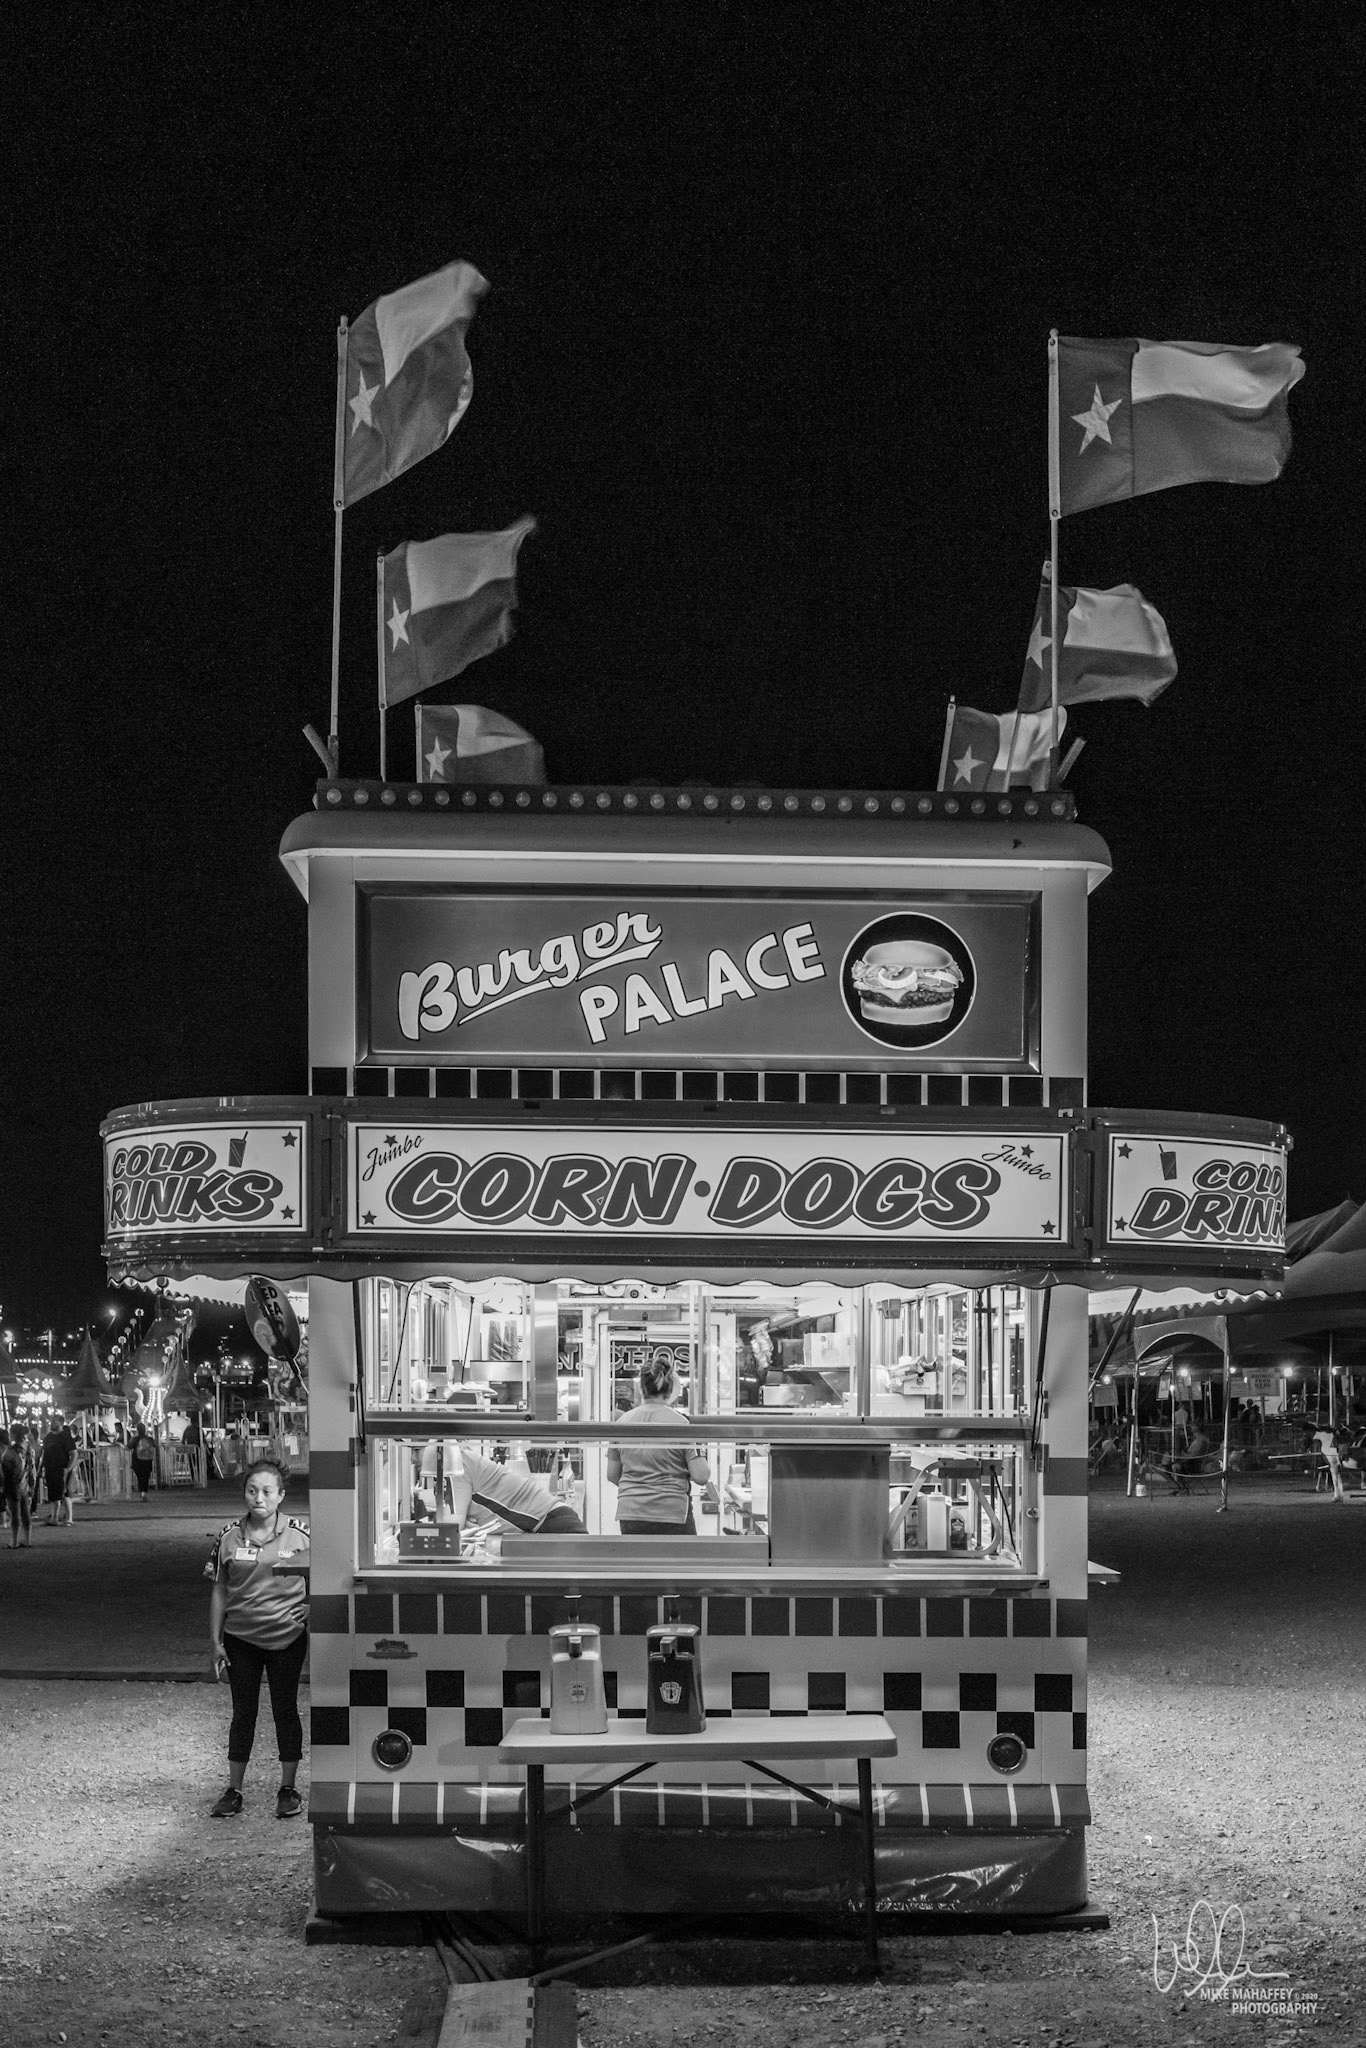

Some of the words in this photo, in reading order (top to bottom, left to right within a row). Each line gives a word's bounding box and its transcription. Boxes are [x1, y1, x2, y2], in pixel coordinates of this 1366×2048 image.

[398, 912, 662, 1041] Burger
[578, 922, 827, 1044] PALACE
[111, 1141, 216, 1181] COLD
[362, 1135, 425, 1181] Jumbo
[982, 1144, 1052, 1181] Jumbo
[1192, 1159, 1285, 1197] COLD
[106, 1169, 283, 1228] RINKS
[1129, 1187, 1286, 1245] DRINK
